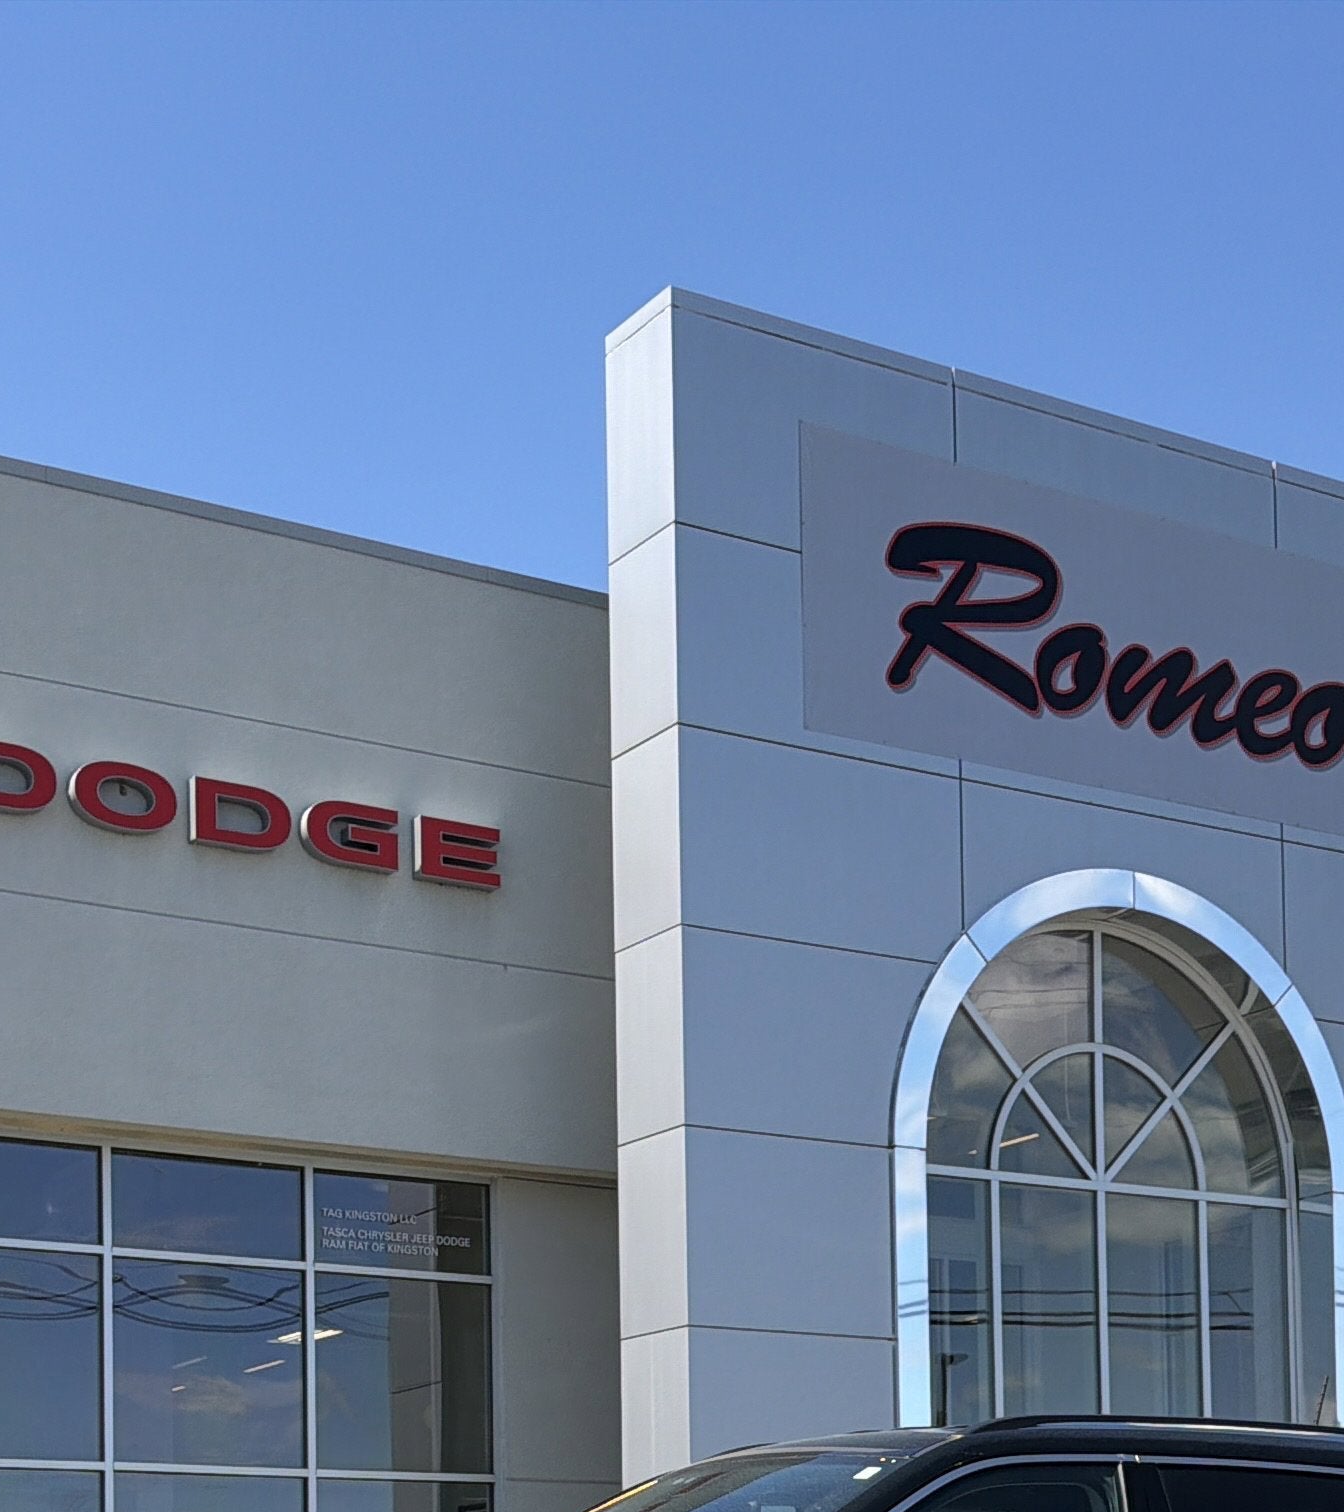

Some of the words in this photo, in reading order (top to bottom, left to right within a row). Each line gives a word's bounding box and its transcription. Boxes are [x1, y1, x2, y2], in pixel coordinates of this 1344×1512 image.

[321, 1207, 344, 1219] TAG
[344, 1209, 399, 1224] KINGSTON
[322, 1227, 356, 1239] TASCA
[357, 1229, 409, 1243] CHRYSLER
[410, 1233, 435, 1244] JEEP
[436, 1235, 471, 1248] DODGE
[322, 1239, 347, 1250] RAM
[348, 1241, 370, 1251] FIAT
[371, 1242, 385, 1253] OF
[387, 1244, 439, 1257] KINGSTON
